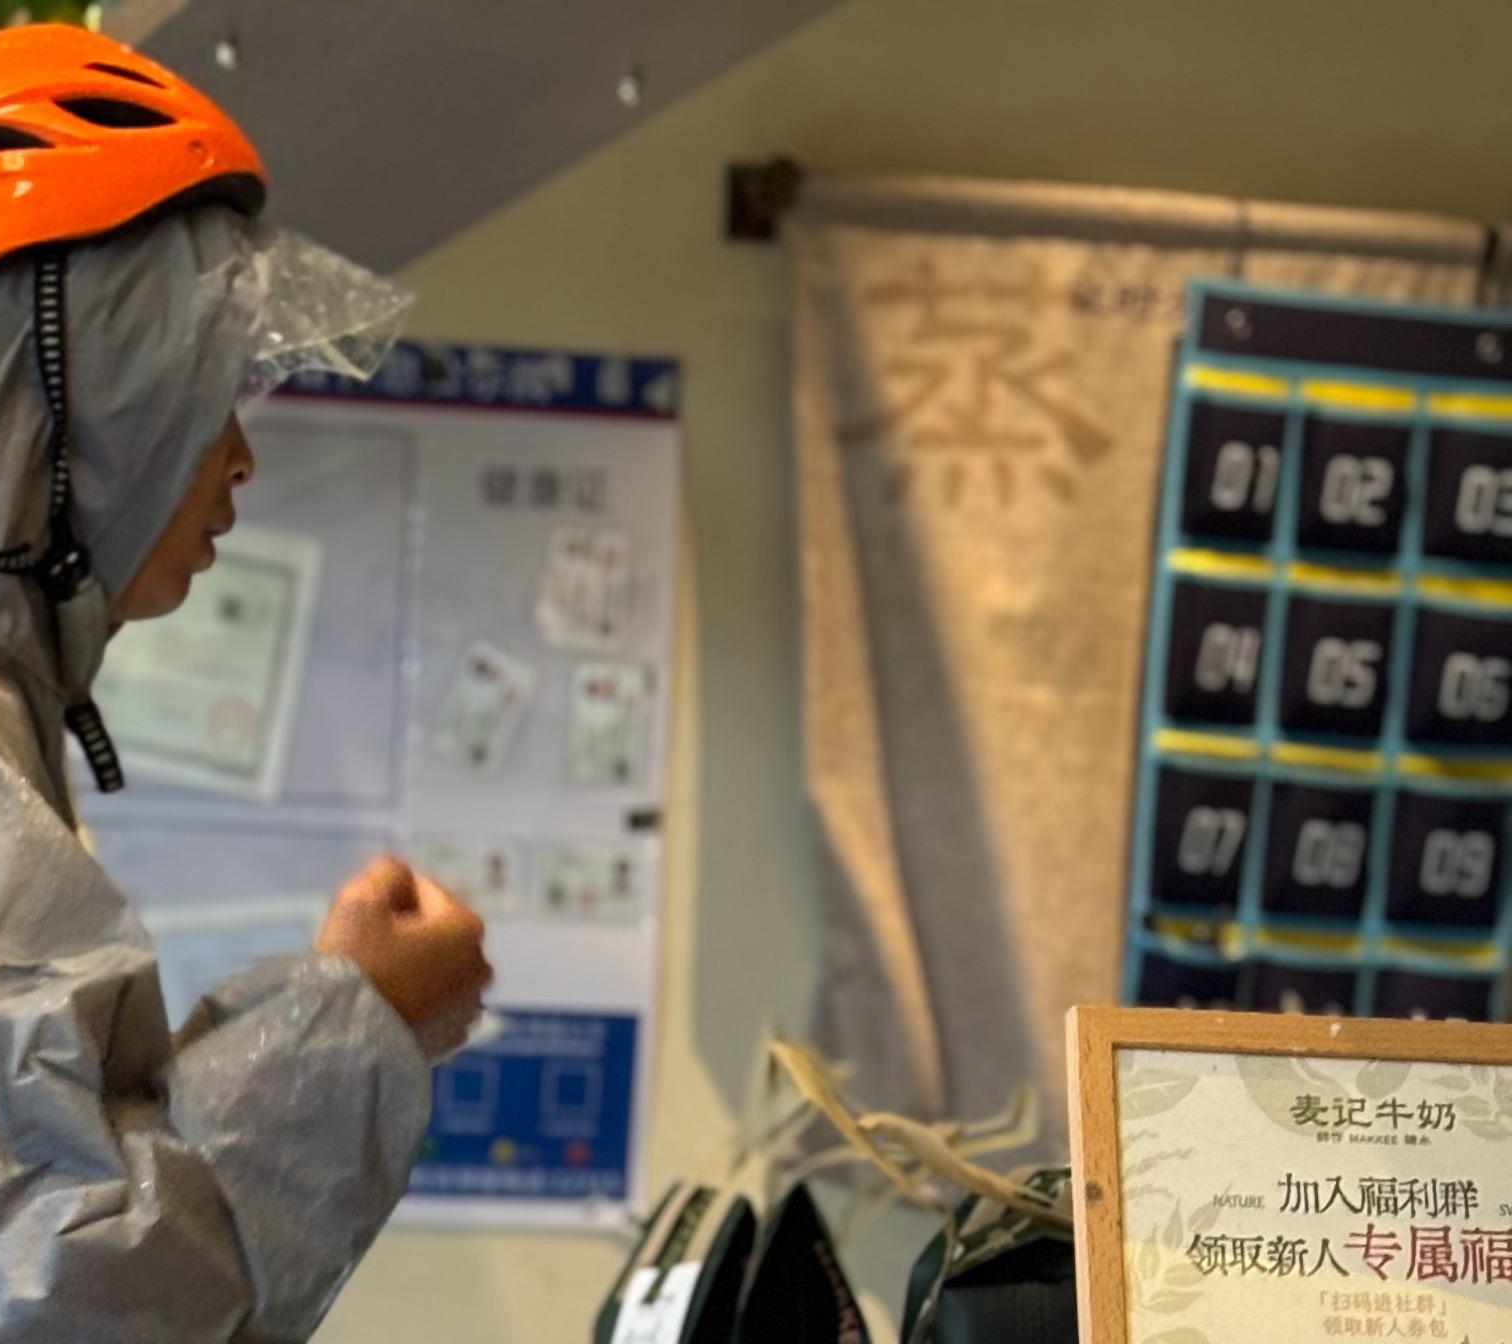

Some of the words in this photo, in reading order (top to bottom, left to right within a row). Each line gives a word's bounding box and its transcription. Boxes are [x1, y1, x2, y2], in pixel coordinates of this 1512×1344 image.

[1210, 440, 1281, 513] 01
[1319, 454, 1395, 526] 02
[1194, 623, 1261, 694] 04
[1307, 636, 1383, 709] 05
[1438, 651, 1510, 722] 06
[1178, 807, 1246, 876] 07
[1292, 818, 1366, 889] 08
[1420, 828, 1495, 898] 09
[1289, 1094, 1456, 1132] 麦记牛奶
[1277, 1172, 1479, 1220] 加入福利群
[1187, 1222, 1512, 1285] 领取新人专属福
